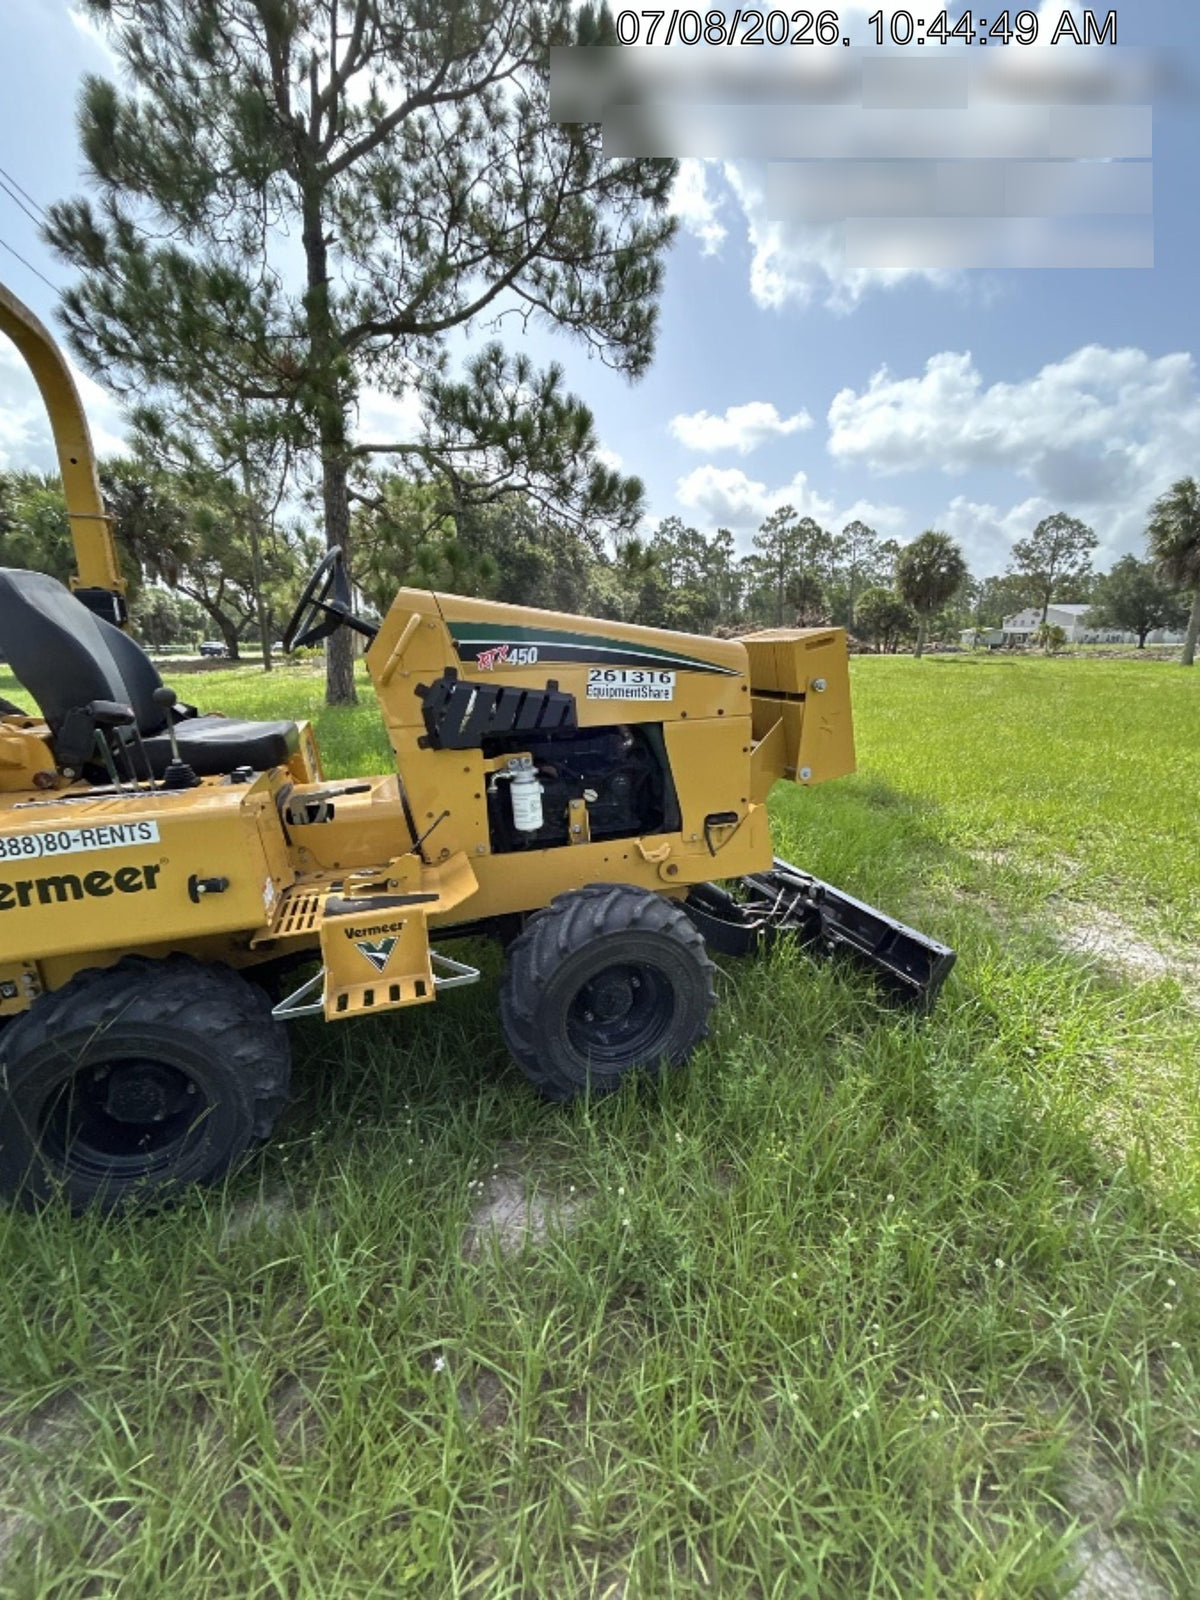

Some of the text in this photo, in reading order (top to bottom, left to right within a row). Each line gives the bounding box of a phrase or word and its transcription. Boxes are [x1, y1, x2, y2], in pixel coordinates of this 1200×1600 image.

[589, 669, 671, 684] 261316
[586, 684, 670, 699] EquipmentShare
[344, 922, 404, 939] Vermeer
